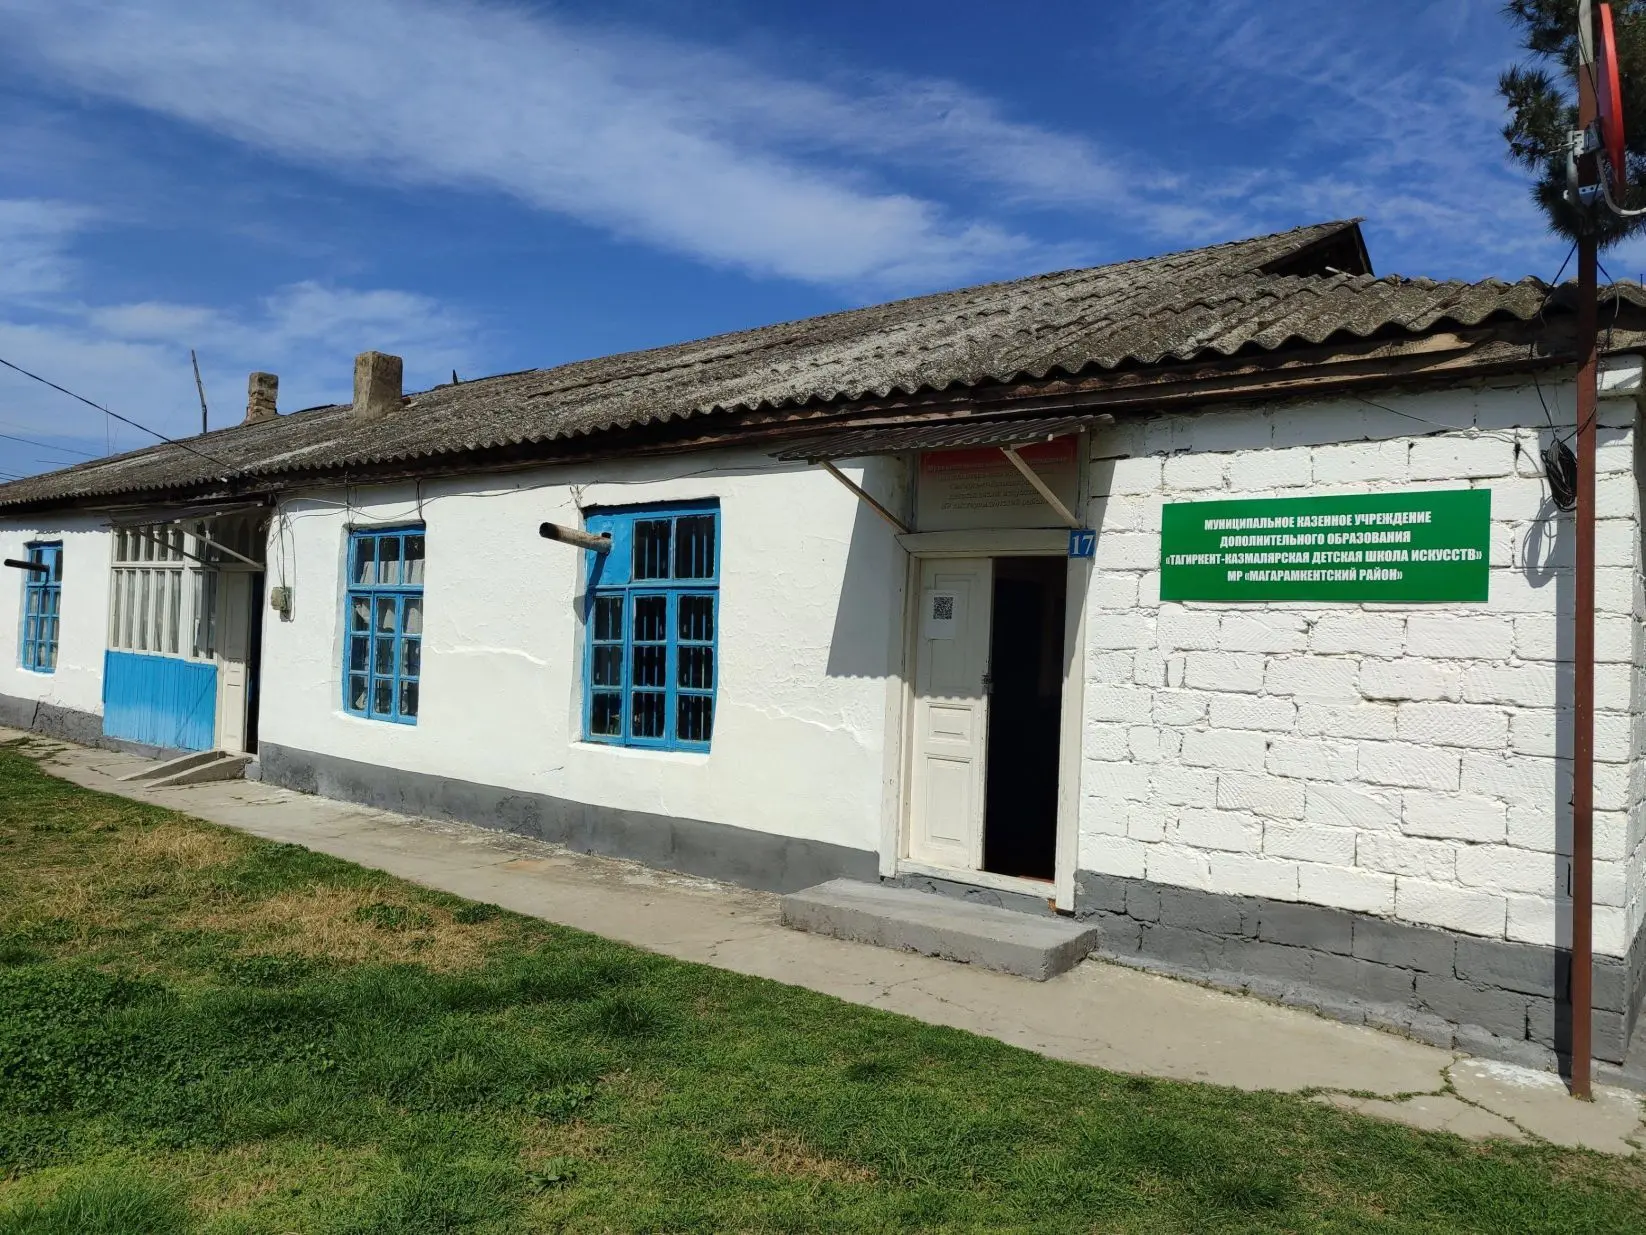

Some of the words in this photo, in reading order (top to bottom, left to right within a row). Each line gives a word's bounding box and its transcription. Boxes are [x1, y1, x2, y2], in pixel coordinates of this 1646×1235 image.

[1204, 518, 1295, 531] МУНИЦИПАЛЬНОЕ
[1297, 515, 1353, 528] КАЗЕННОЕ
[1354, 511, 1432, 525] УЧРЕЖДЕНИЕ
[1072, 535, 1093, 554] 17
[1220, 534, 1325, 548] ДОПОЛНИТЕЛЬНОГО
[1327, 531, 1411, 545] ОБРАЗОВАНИЯ
[1312, 551, 1363, 564] ДЕТСКАЯ
[1365, 550, 1409, 562] ШКОЛА
[1411, 549, 1482, 561] ИСКУССТВ»
[1227, 570, 1243, 582] МР
[1245, 567, 1357, 581] «МАГАРАМКЕНТСКИЙ
[1359, 567, 1403, 581] РАЙОН»
